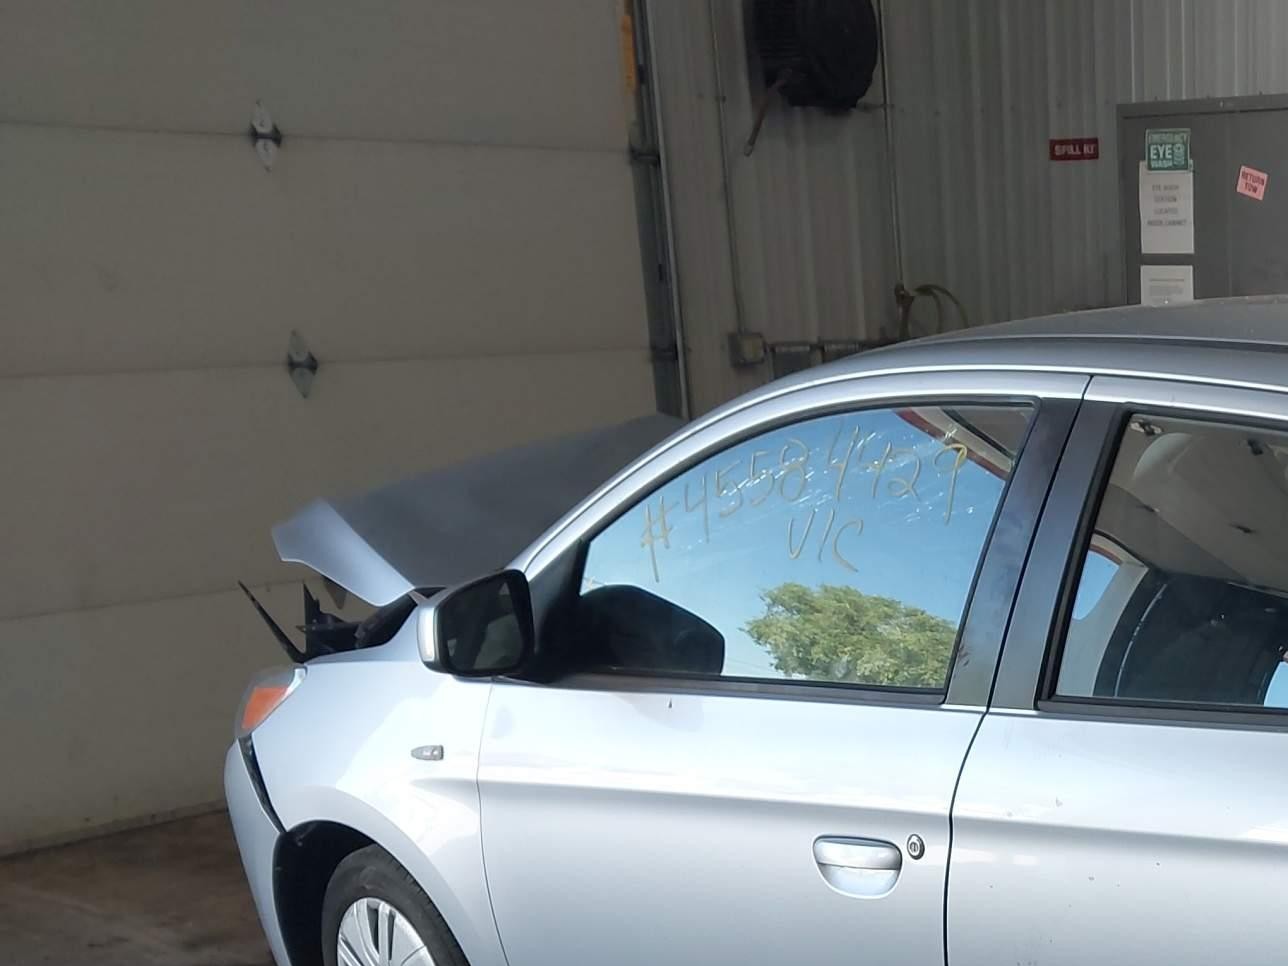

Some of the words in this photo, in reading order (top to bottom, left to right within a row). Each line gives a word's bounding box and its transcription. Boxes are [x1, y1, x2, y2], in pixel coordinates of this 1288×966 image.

[1150, 144, 1173, 160] EYE
[1151, 160, 1174, 169] WASH
[1241, 170, 1265, 186] RETURN
[1244, 182, 1258, 194] TOW
